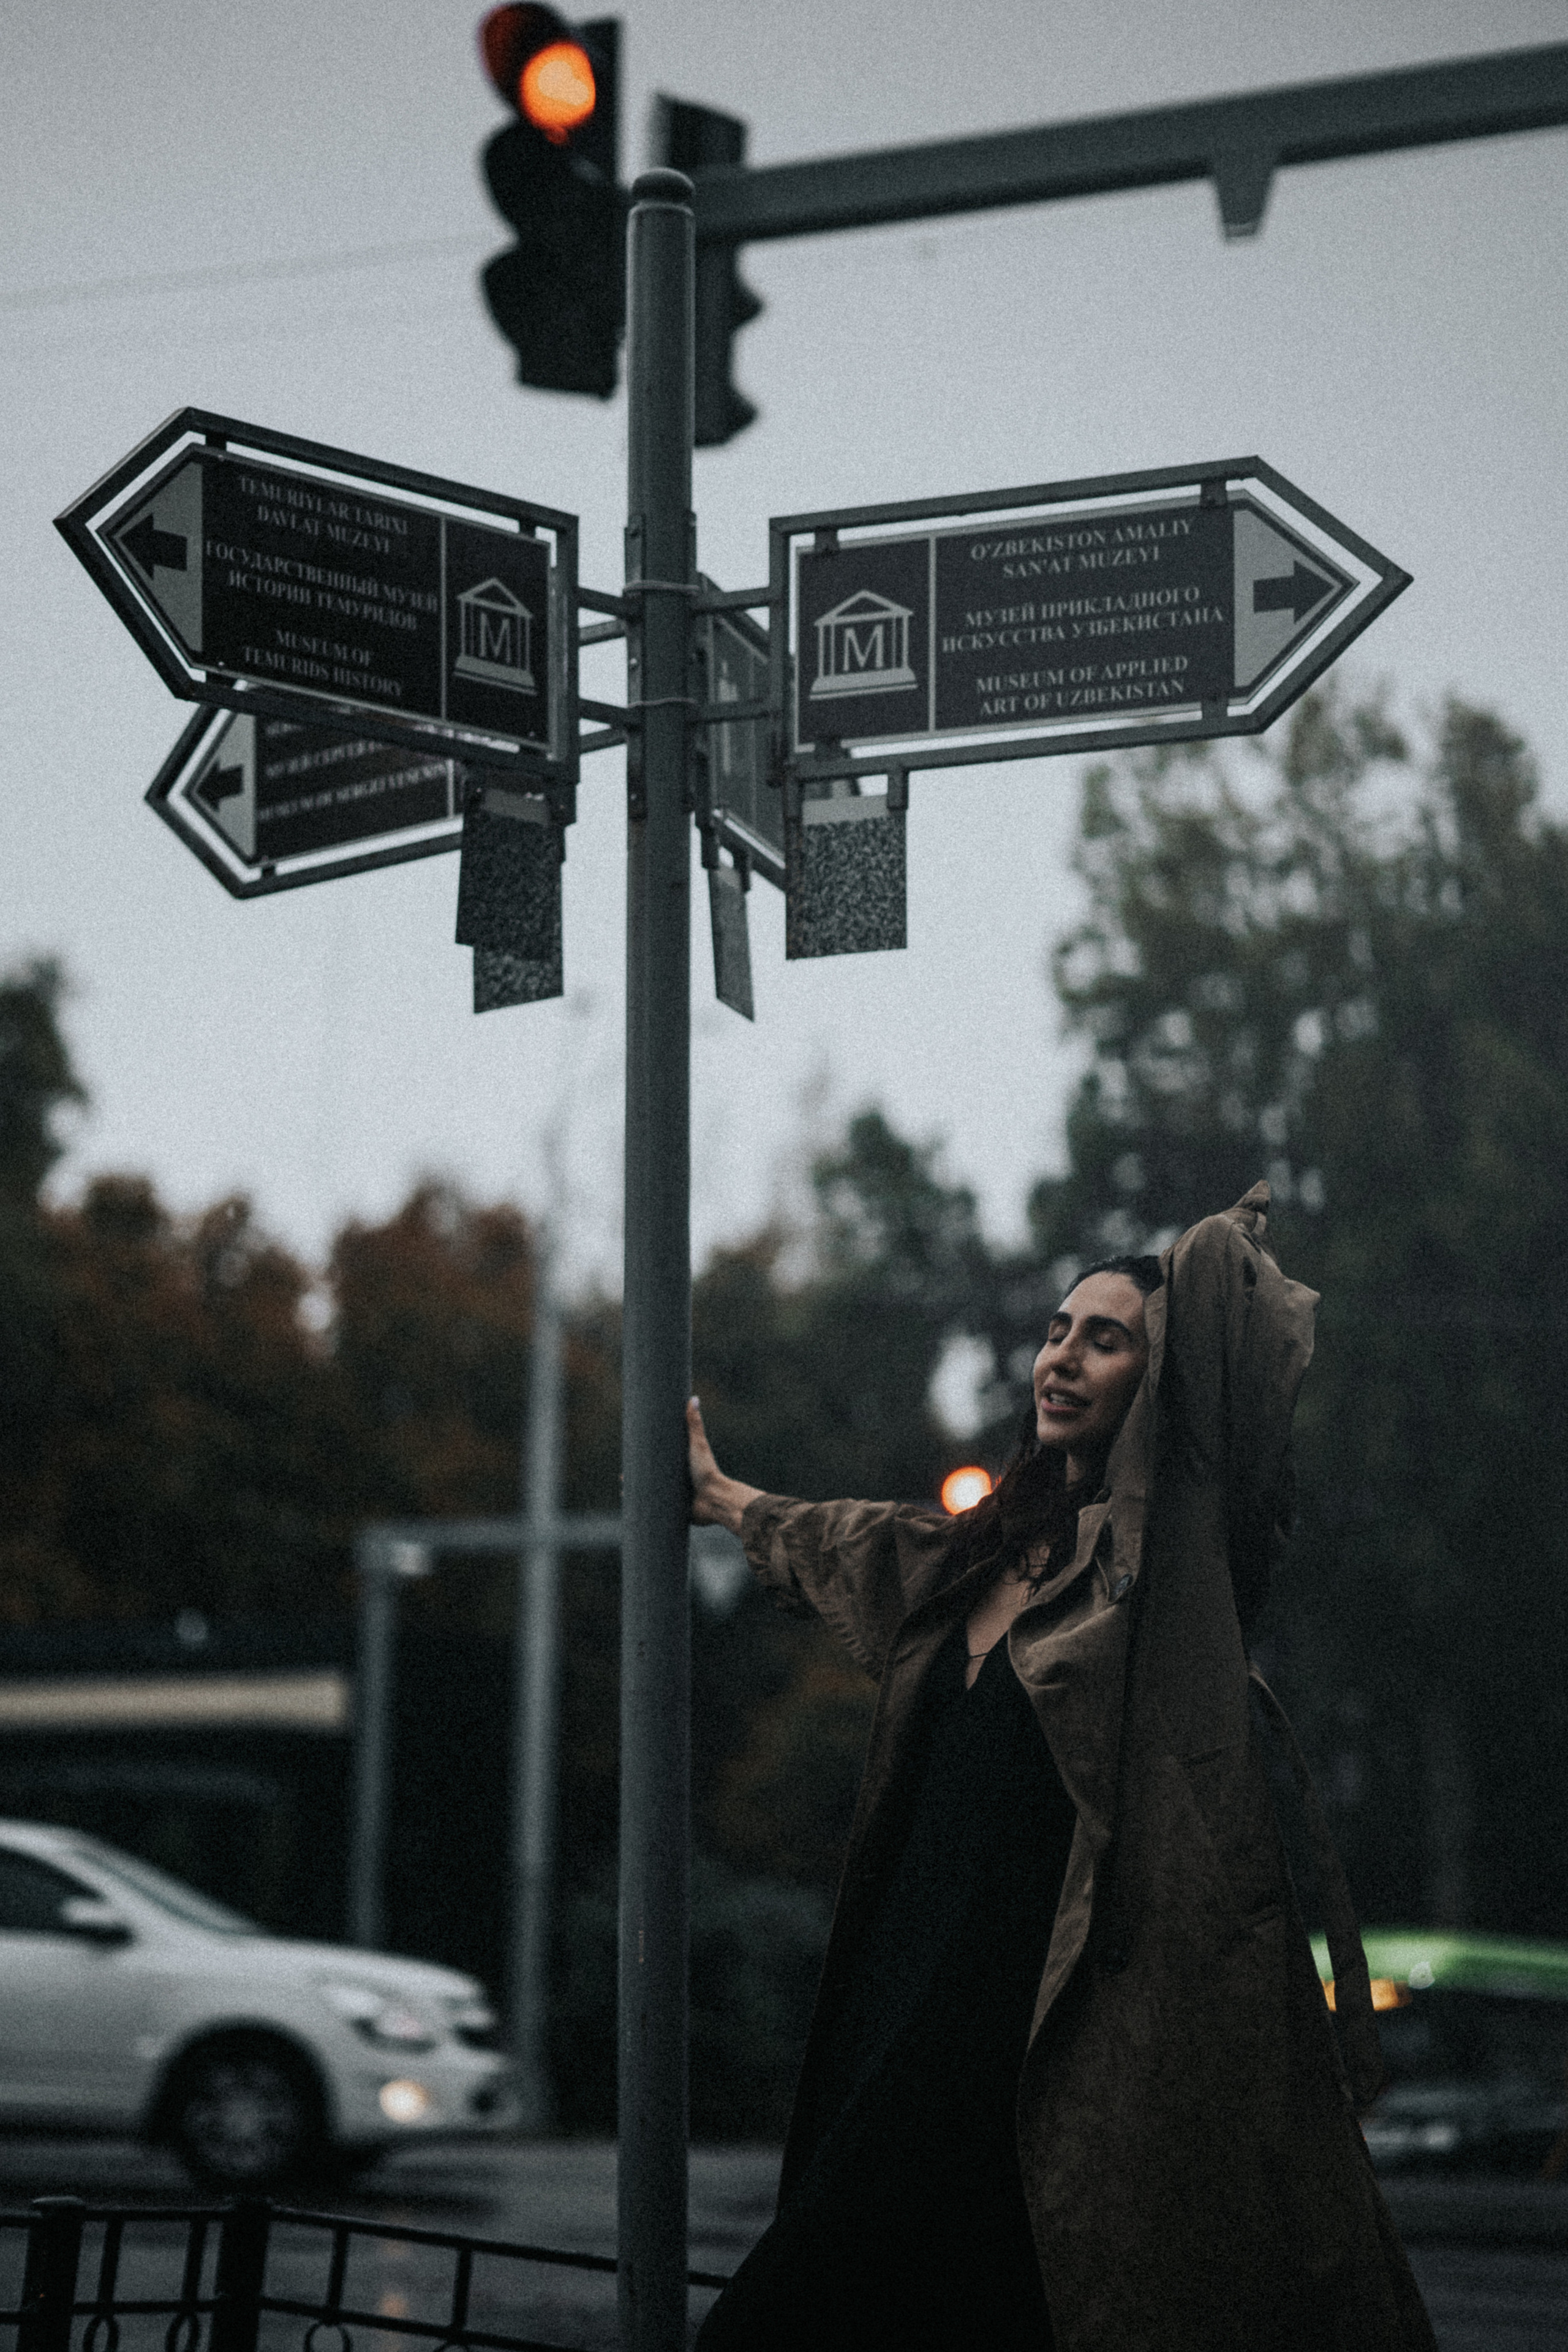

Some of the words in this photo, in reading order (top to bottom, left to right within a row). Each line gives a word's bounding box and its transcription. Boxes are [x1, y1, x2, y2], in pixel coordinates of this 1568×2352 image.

[328, 522, 390, 554] MUZEYI
[970, 530, 1106, 561] O'ZBEKISTON
[1110, 518, 1192, 543] AMALIY
[206, 540, 379, 597] ГОСУДАРСТВЕННЫЙ
[383, 582, 438, 612] МУЗЕЙ
[1003, 556, 1071, 579] SAN'AT
[1079, 545, 1160, 569] MUZEYI
[228, 570, 311, 605] ИСТОРИИ
[965, 602, 1035, 628] МУЗЕЙ
[1041, 586, 1200, 619] ПРИКЛАДНОГО
[276, 630, 347, 661] MUSEUM
[352, 647, 371, 666] OF
[941, 624, 1066, 654] ИСКУССТВА
[1072, 606, 1224, 639] УЗБЕКИСТАНА
[244, 646, 329, 681] TEMURIDS
[333, 666, 402, 696] HISTORY
[976, 668, 1065, 694] MUSEUM
[1069, 665, 1098, 684] OF
[1101, 655, 1189, 680] APPLIED
[980, 695, 1020, 715] ART
[1024, 692, 1052, 711] OF
[1056, 678, 1186, 707] UZBEKISTAN
